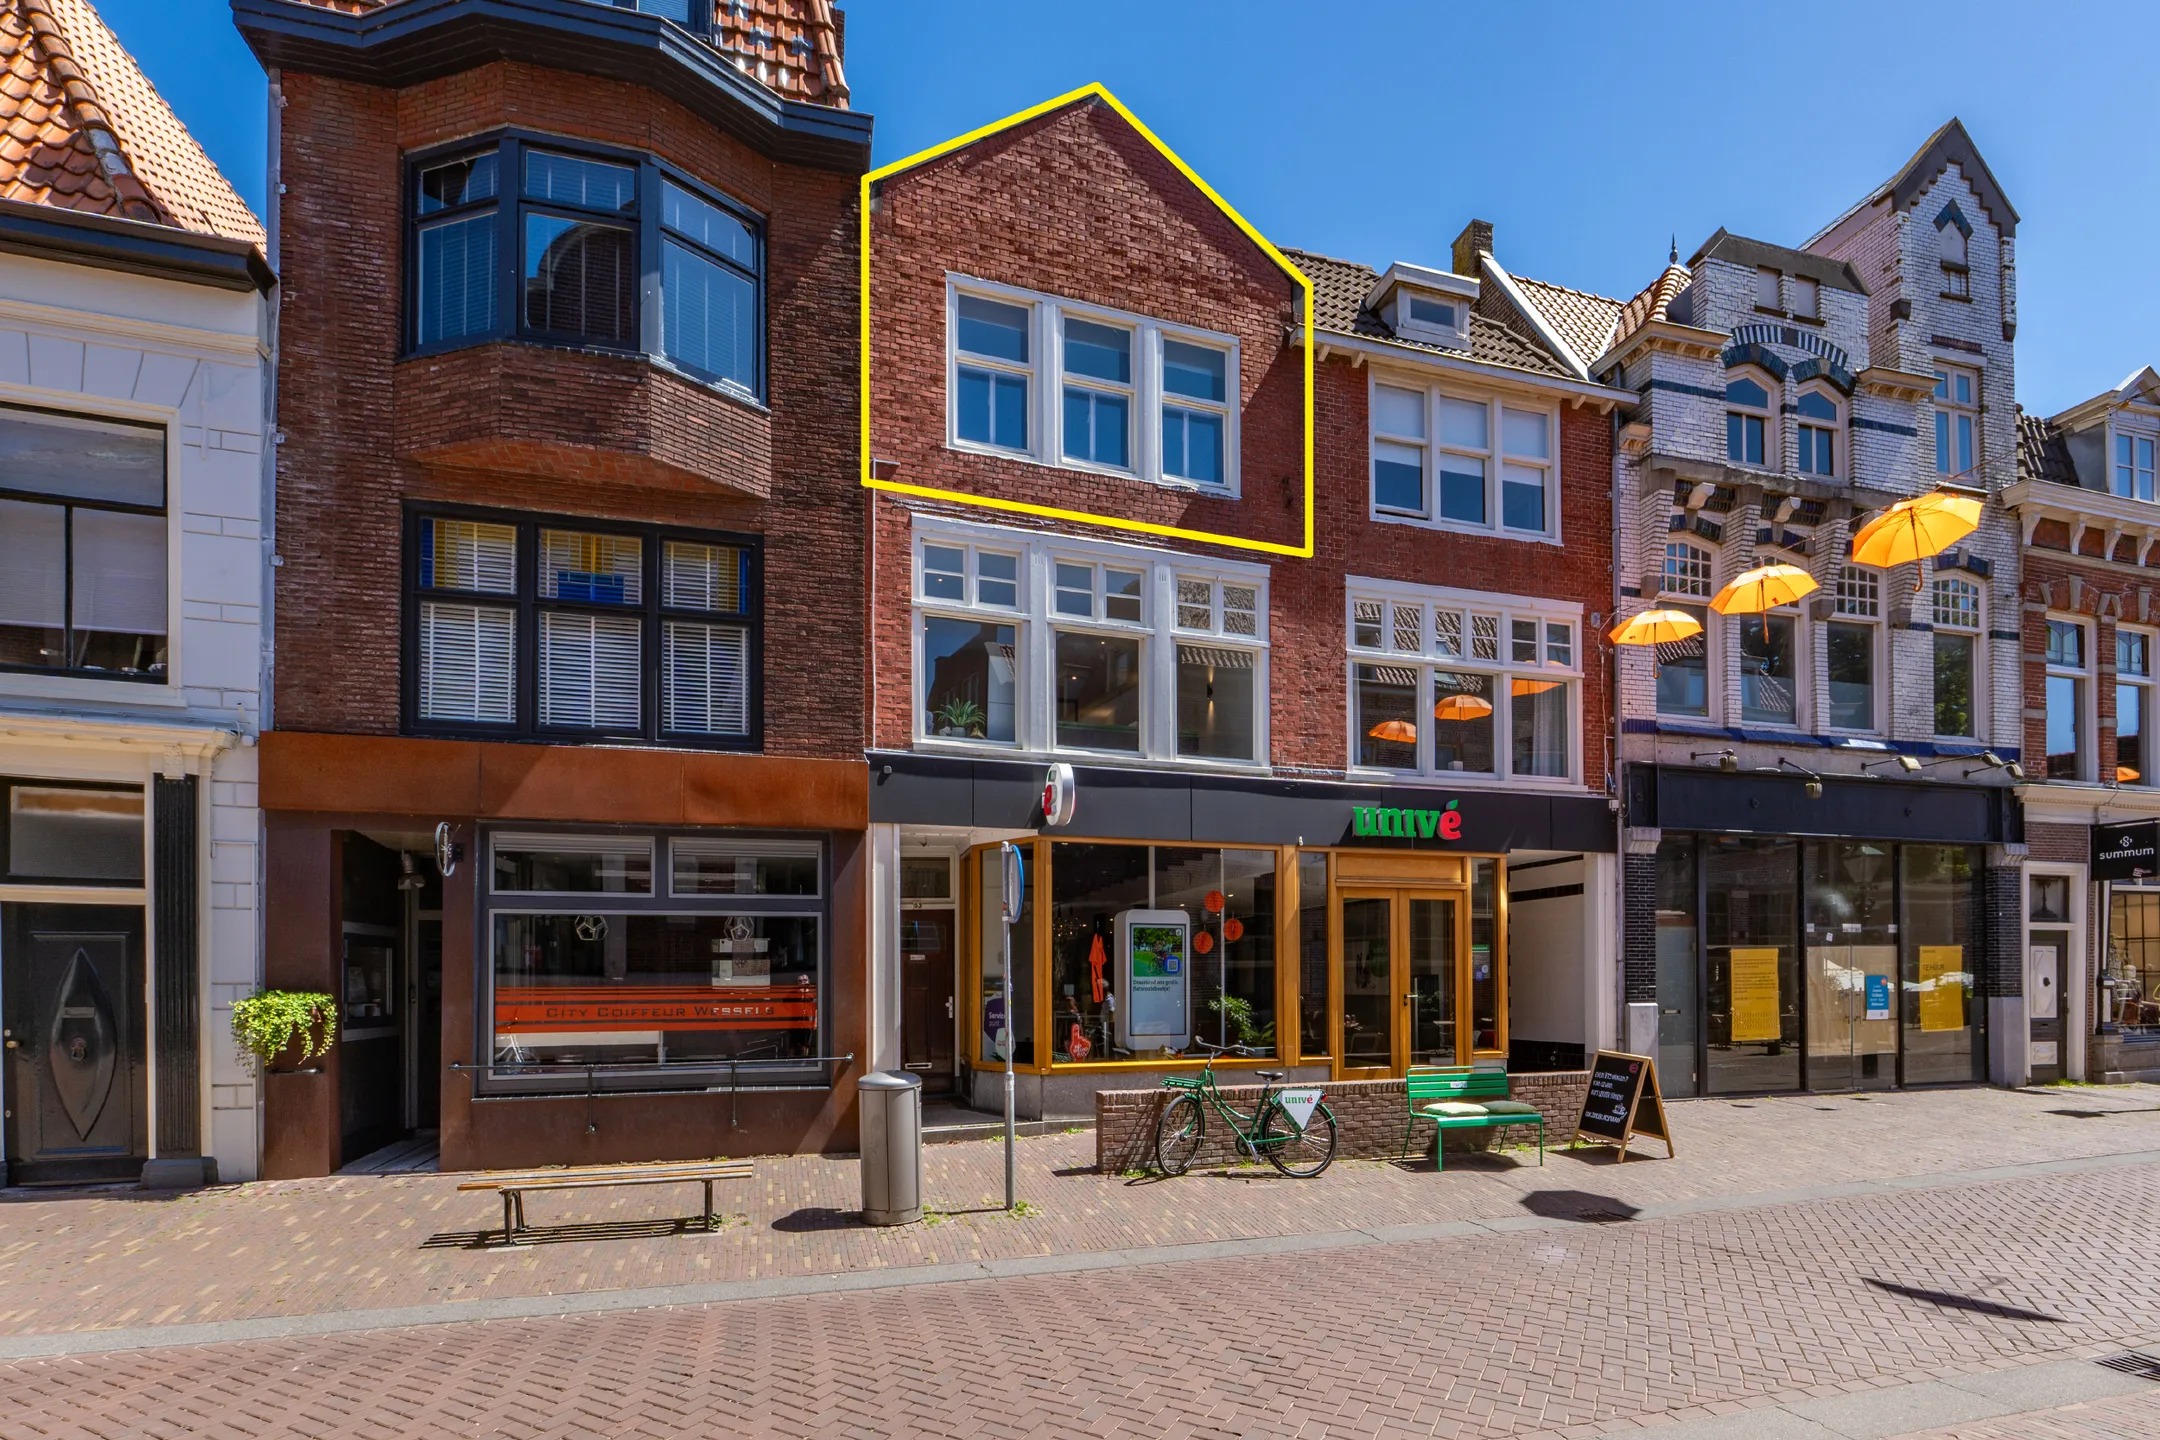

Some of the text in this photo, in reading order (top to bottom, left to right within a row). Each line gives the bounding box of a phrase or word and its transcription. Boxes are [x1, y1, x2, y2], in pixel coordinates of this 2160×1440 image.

[1353, 799, 1462, 840] univé
[2099, 848, 2154, 860] summum
[988, 1011, 1006, 1020] Servic
[1284, 1094, 1314, 1104] univé
